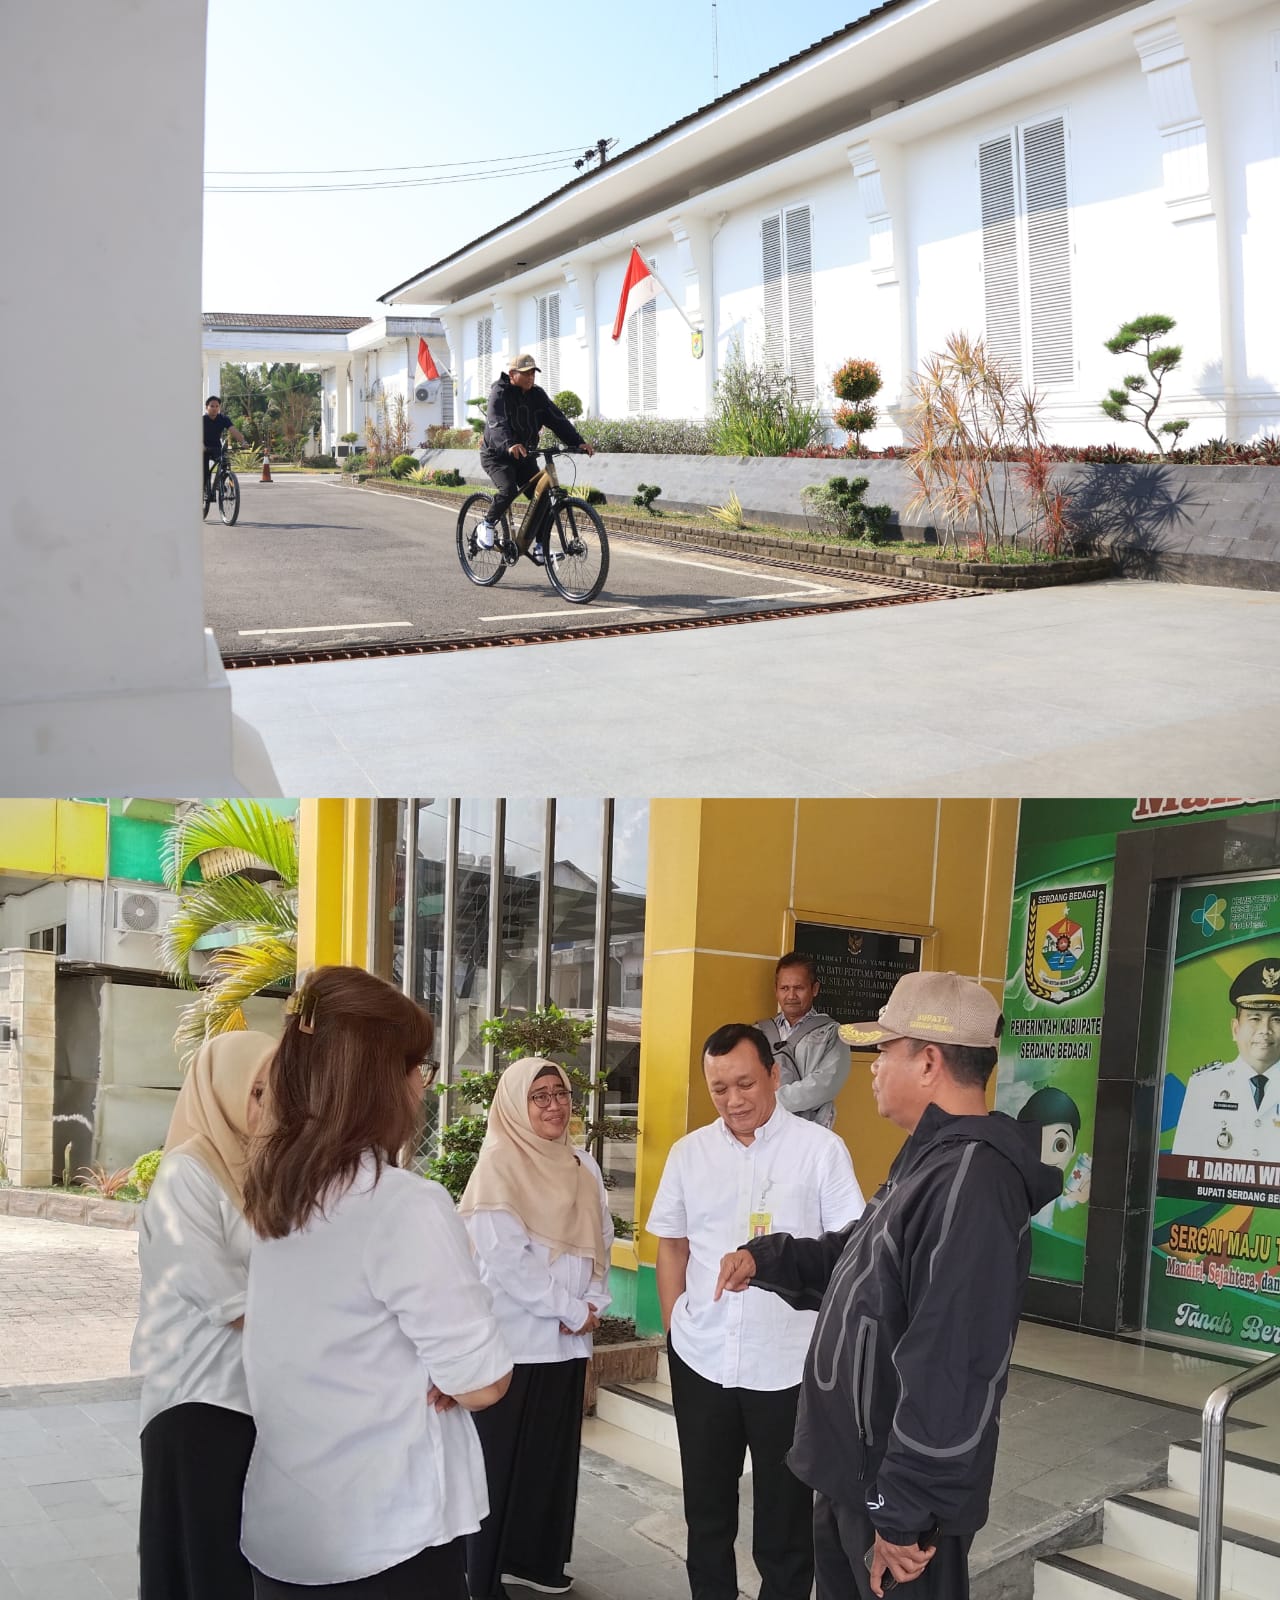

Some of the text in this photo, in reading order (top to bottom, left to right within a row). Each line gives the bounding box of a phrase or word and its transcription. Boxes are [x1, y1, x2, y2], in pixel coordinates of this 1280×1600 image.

[1037, 890, 1098, 904] SERDANG BEDAGAI
[1010, 1016, 1102, 1036] PEMERINTAH KABUPATE
[1020, 1042, 1092, 1059] SERDANG BEDAGAI
[1187, 1159, 1201, 1179] H.
[1203, 1160, 1256, 1184] DARMA
[1197, 1186, 1225, 1198] BUPATI
[1227, 1189, 1266, 1202] SERDANG
[1169, 1223, 1223, 1254] SERGAI
[1227, 1231, 1272, 1262] MAJU
[1166, 1256, 1280, 1293] Mandiri, Sejahtera, dan
[1175, 1303, 1232, 1334] Tanah
